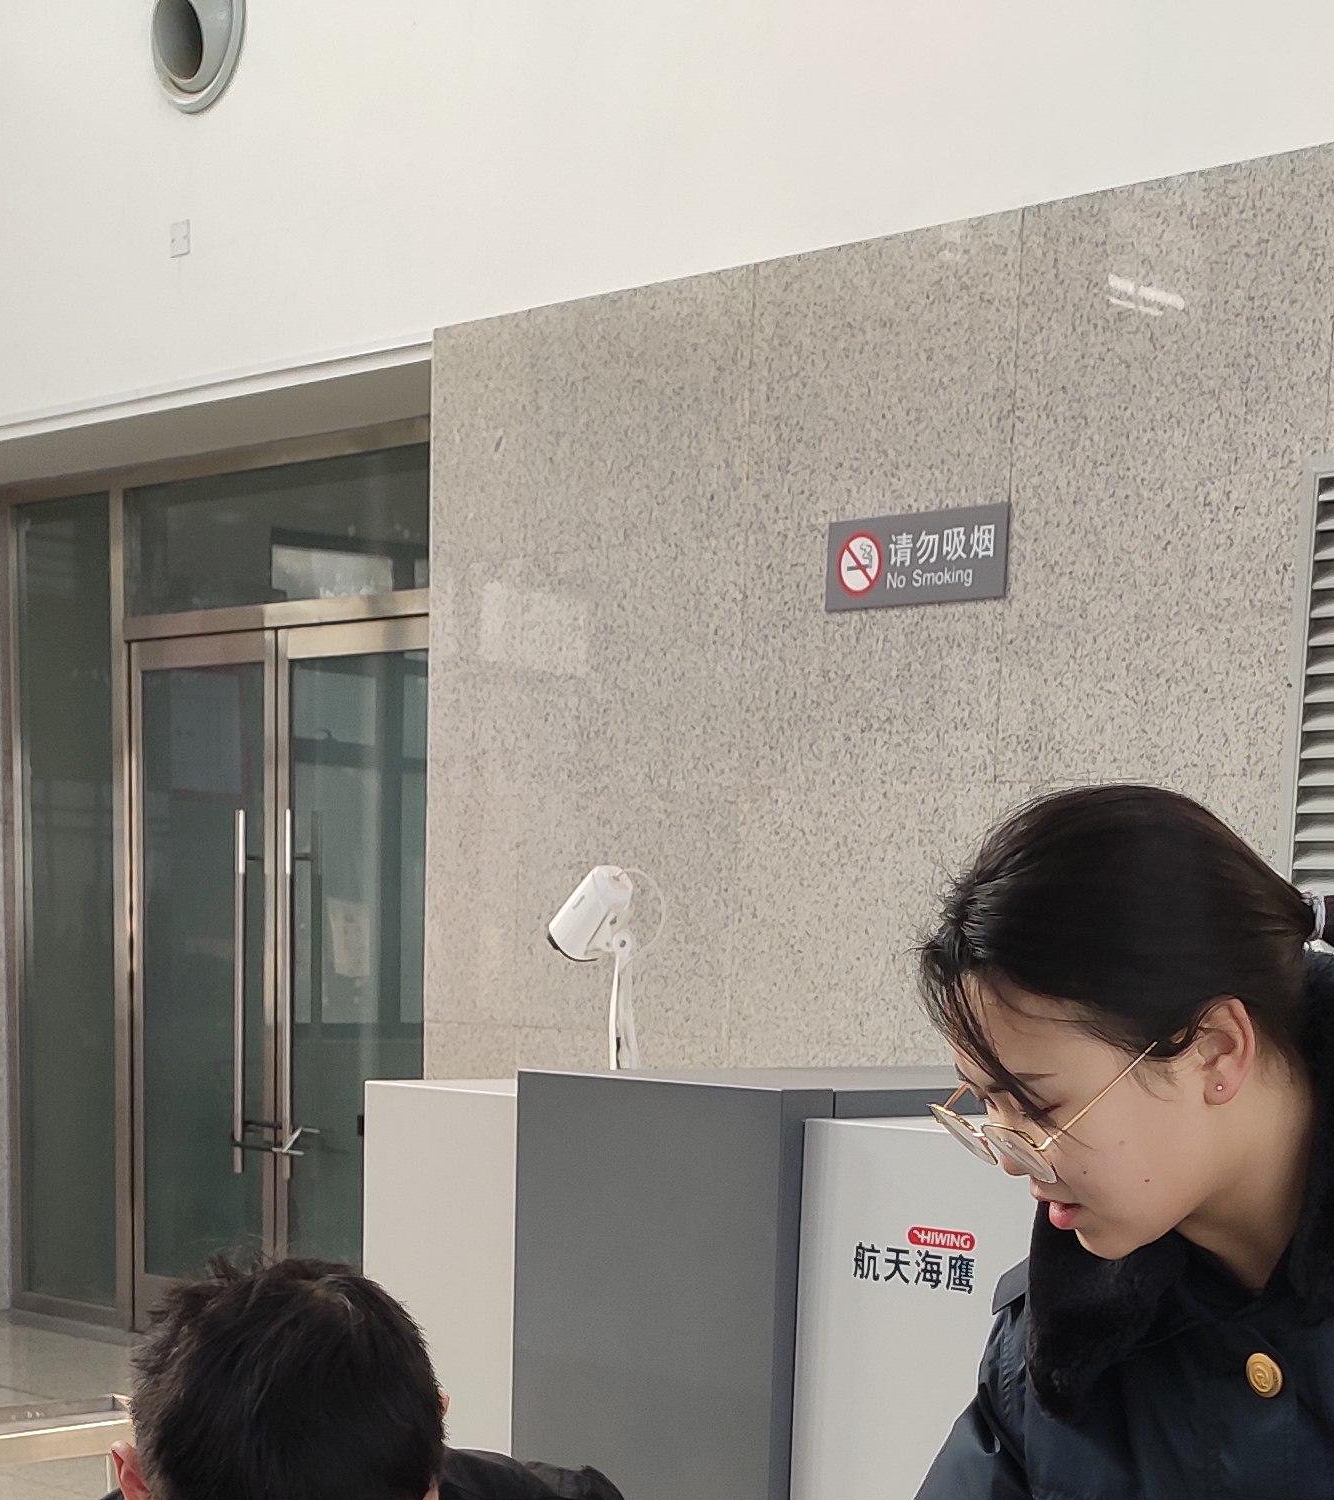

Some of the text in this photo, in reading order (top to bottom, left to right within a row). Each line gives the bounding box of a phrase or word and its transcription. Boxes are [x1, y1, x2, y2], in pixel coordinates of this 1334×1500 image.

[888, 524, 996, 568] 请勿吸烟
[886, 567, 973, 589] No Smoking
[852, 1241, 976, 1295] 航天海鹰
